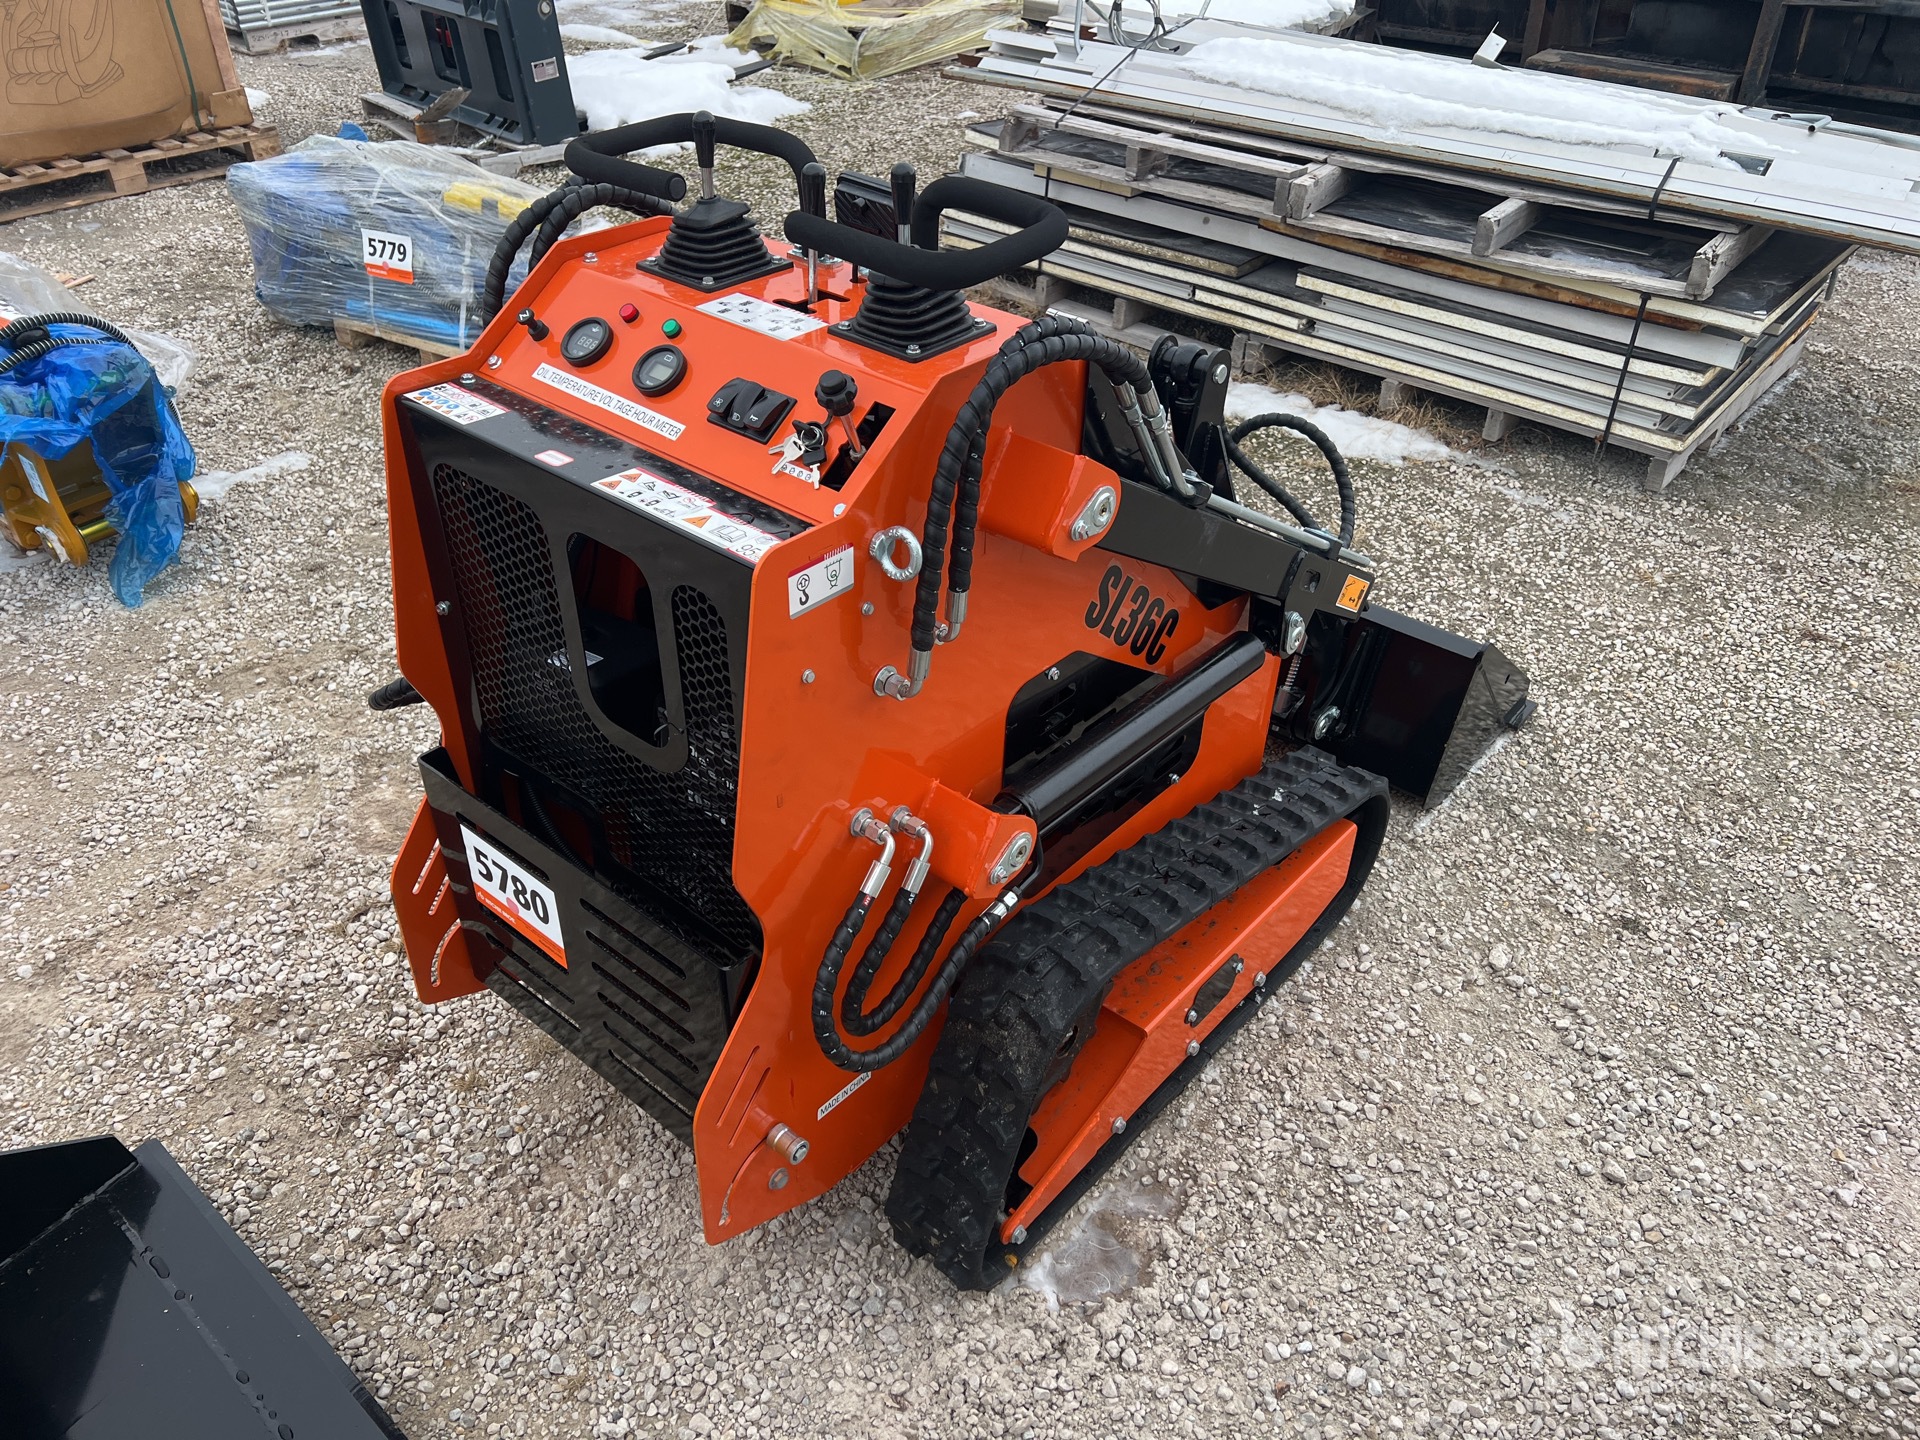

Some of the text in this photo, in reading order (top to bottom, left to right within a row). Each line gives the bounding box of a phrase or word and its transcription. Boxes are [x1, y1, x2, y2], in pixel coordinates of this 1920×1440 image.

[368, 237, 407, 262] 5779
[536, 367, 549, 379] OIL
[547, 372, 602, 401] TEMPERATURE
[632, 408, 656, 426] HOUR
[653, 419, 681, 438] METER
[1085, 565, 1179, 665] SL36C
[473, 845, 550, 925] 5780
[820, 1072, 870, 1115] MADE IN CHINA
